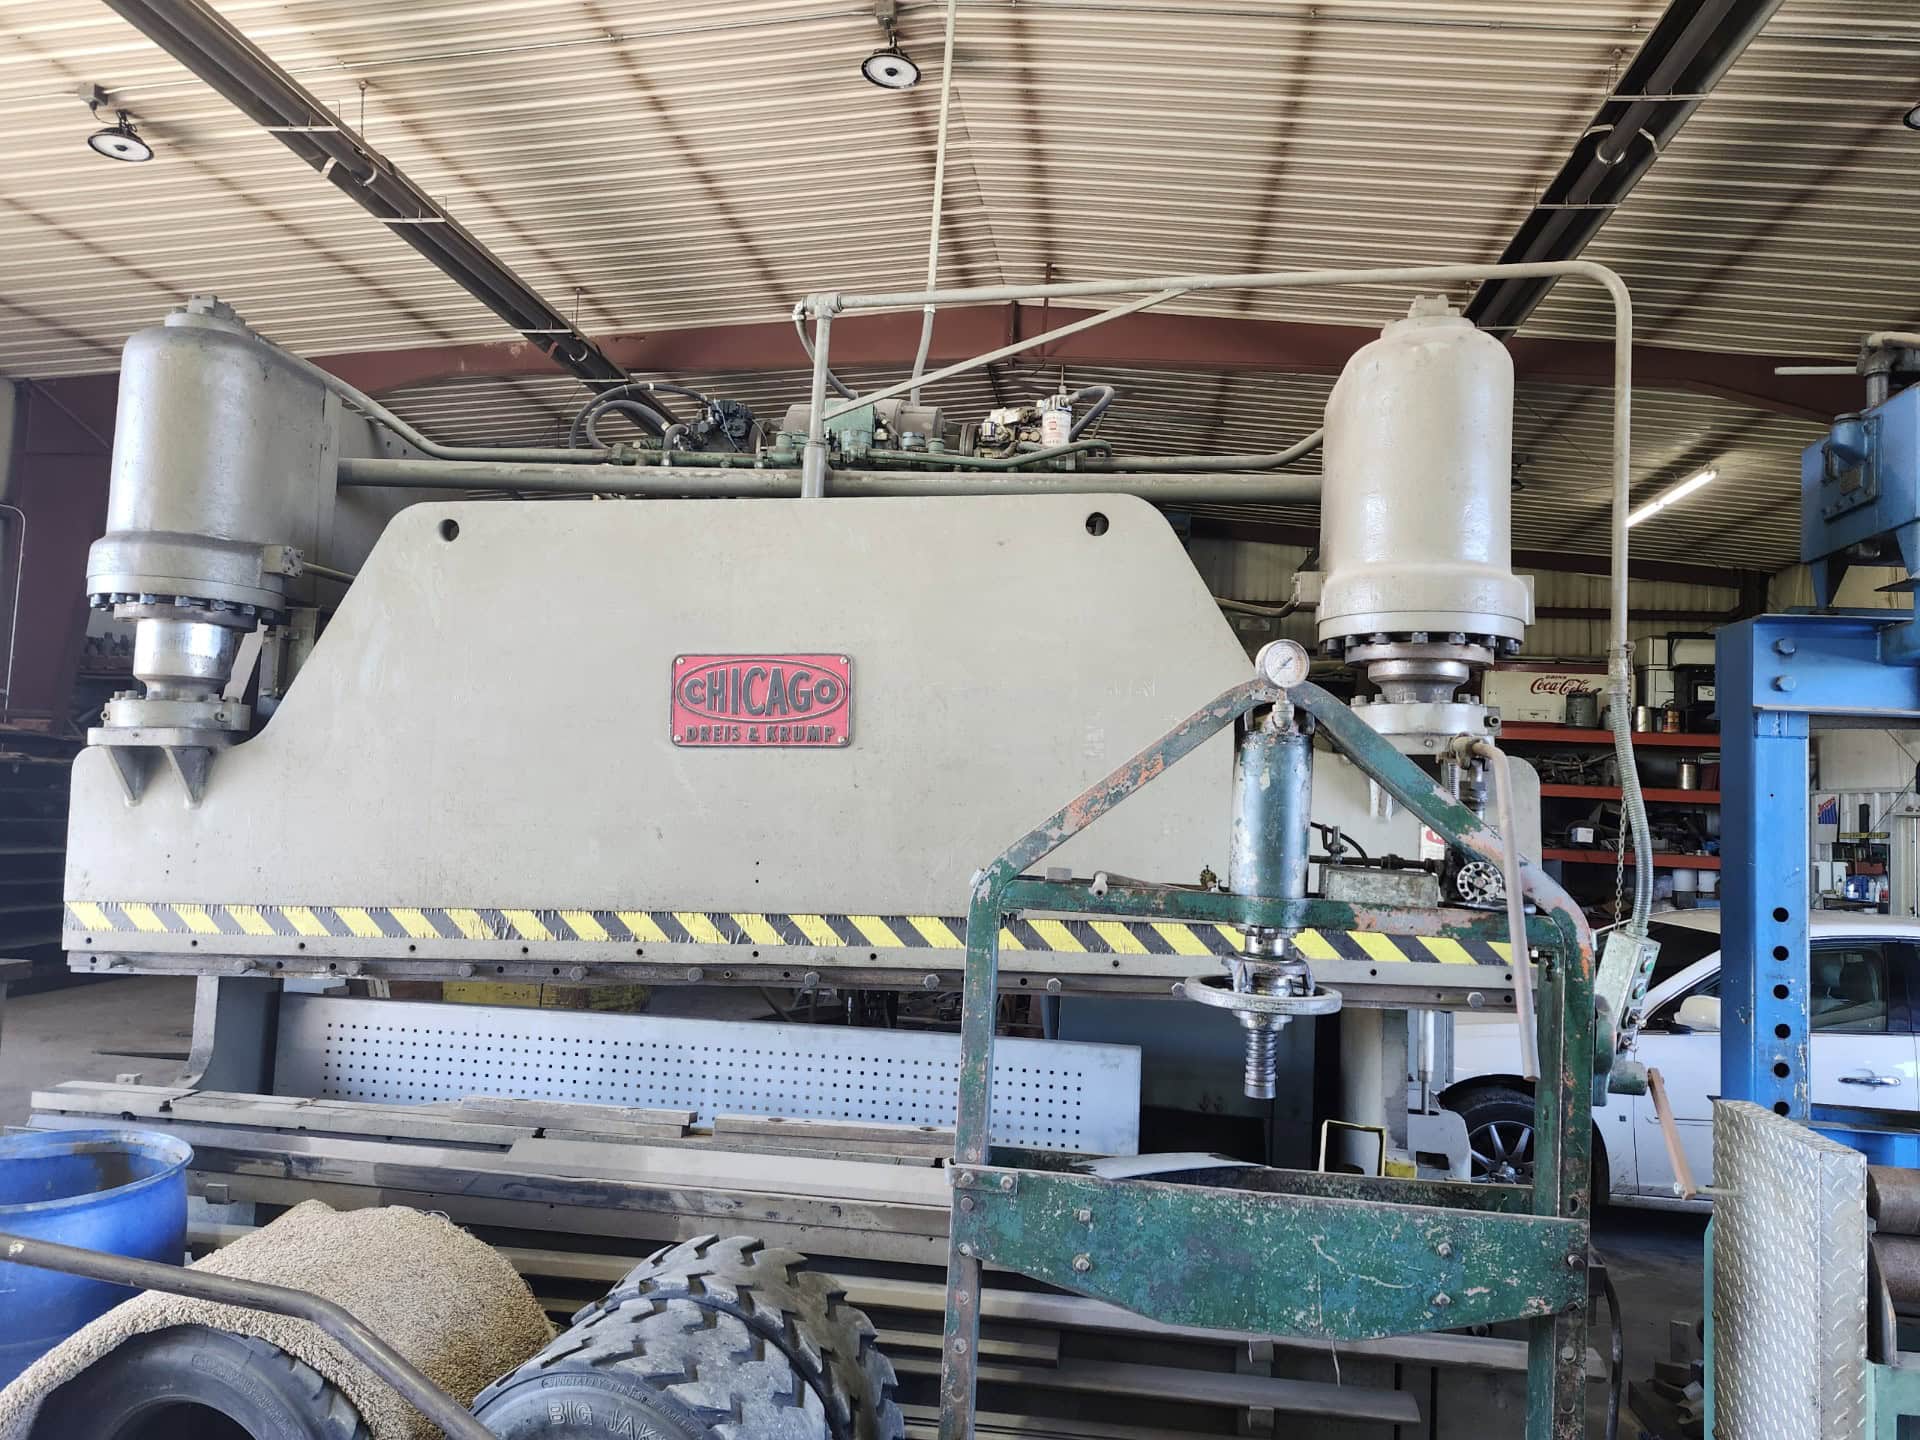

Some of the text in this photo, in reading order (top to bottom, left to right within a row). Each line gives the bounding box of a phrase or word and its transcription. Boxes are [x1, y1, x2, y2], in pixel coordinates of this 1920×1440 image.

[684, 666, 837, 716] CHICAGO
[685, 725, 836, 743] DREIS & KRUMP
[548, 1400, 666, 1440] BIG JAK
